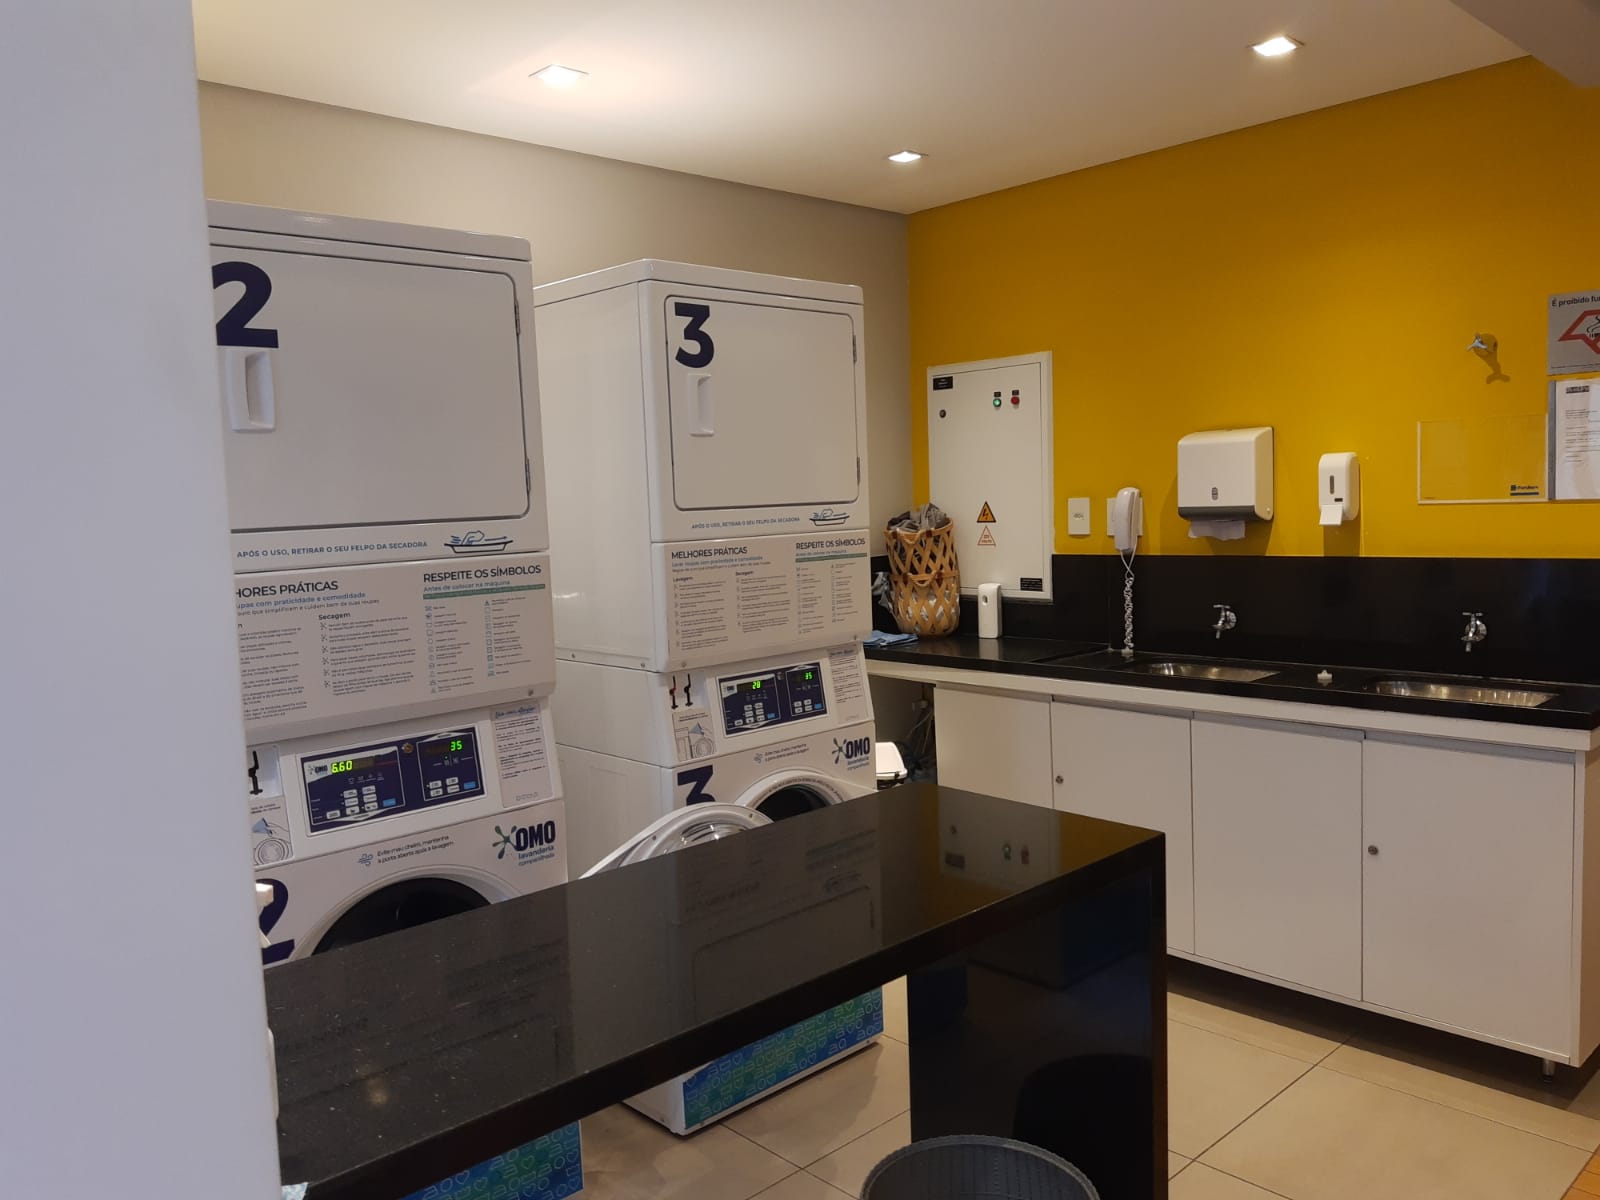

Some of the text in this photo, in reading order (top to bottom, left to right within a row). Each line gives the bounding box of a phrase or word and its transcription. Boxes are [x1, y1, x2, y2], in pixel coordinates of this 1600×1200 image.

[211, 261, 279, 349] 2
[1558, 296, 1590, 308] proibido
[674, 302, 715, 369] 3
[237, 550, 260, 558] APÓS
[270, 548, 290, 556] USO,
[291, 546, 324, 555] RETIRAR
[388, 541, 427, 550] SECADORA
[795, 537, 866, 550] RESPEITE OS SÍMBOLOS
[671, 546, 748, 560] MELHORES PRÁTICAS
[423, 564, 542, 583] RESPEITE OS SÍMBOLOS
[279, 580, 339, 595] PRÁTICAS
[423, 585, 442, 593] Antes
[274, 596, 315, 607] praticidade
[322, 592, 366, 601] comodidade
[318, 611, 351, 621] Secagem
[450, 739, 463, 752] 35
[845, 737, 871, 759] OMO
[514, 820, 556, 852] OMO
[517, 845, 555, 860] lavanderia
[256, 878, 295, 965] 2
